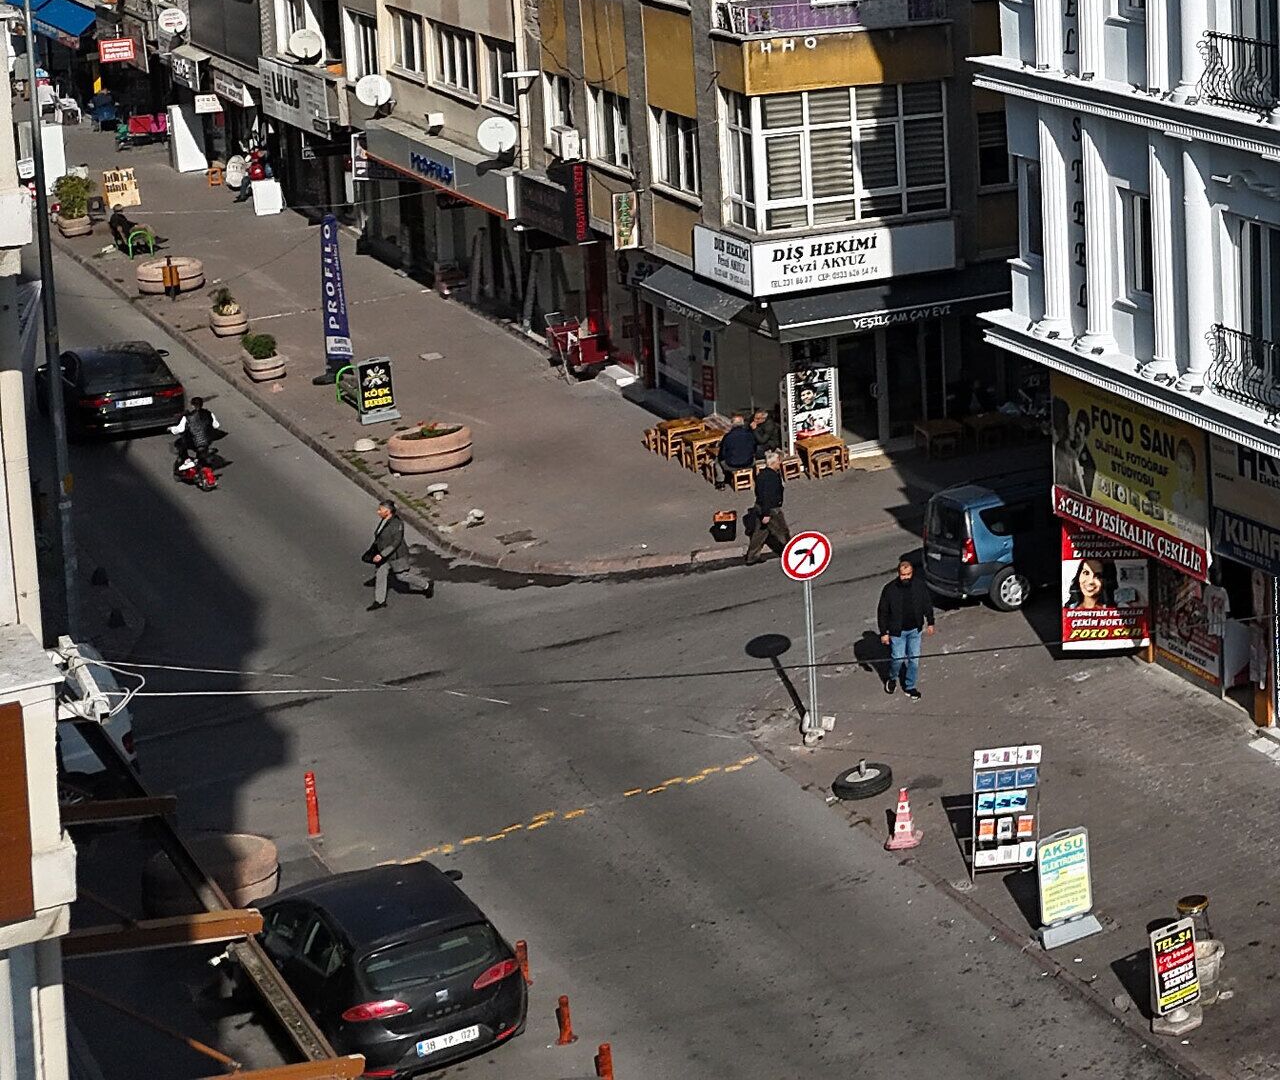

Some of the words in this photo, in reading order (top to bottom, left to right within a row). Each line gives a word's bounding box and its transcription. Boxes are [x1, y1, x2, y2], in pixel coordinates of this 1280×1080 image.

[271, 72, 300, 109] ULUS
[772, 244, 804, 263] DİŞ
[810, 232, 878, 257] HEKİMİ
[821, 251, 867, 270] AKYÜZ
[853, 310, 907, 330] YEŞİLÇAM
[910, 307, 930, 322] ÇAY
[1091, 405, 1133, 444] FOTO
[1140, 423, 1175, 461] SAN
[1058, 496, 1093, 524] ACELE
[1095, 506, 1155, 552] VESİKALIK
[1157, 536, 1202, 572] ÇEKİLİR
[1070, 628, 1107, 638] FOTO
[1043, 837, 1083, 859] AKSU
